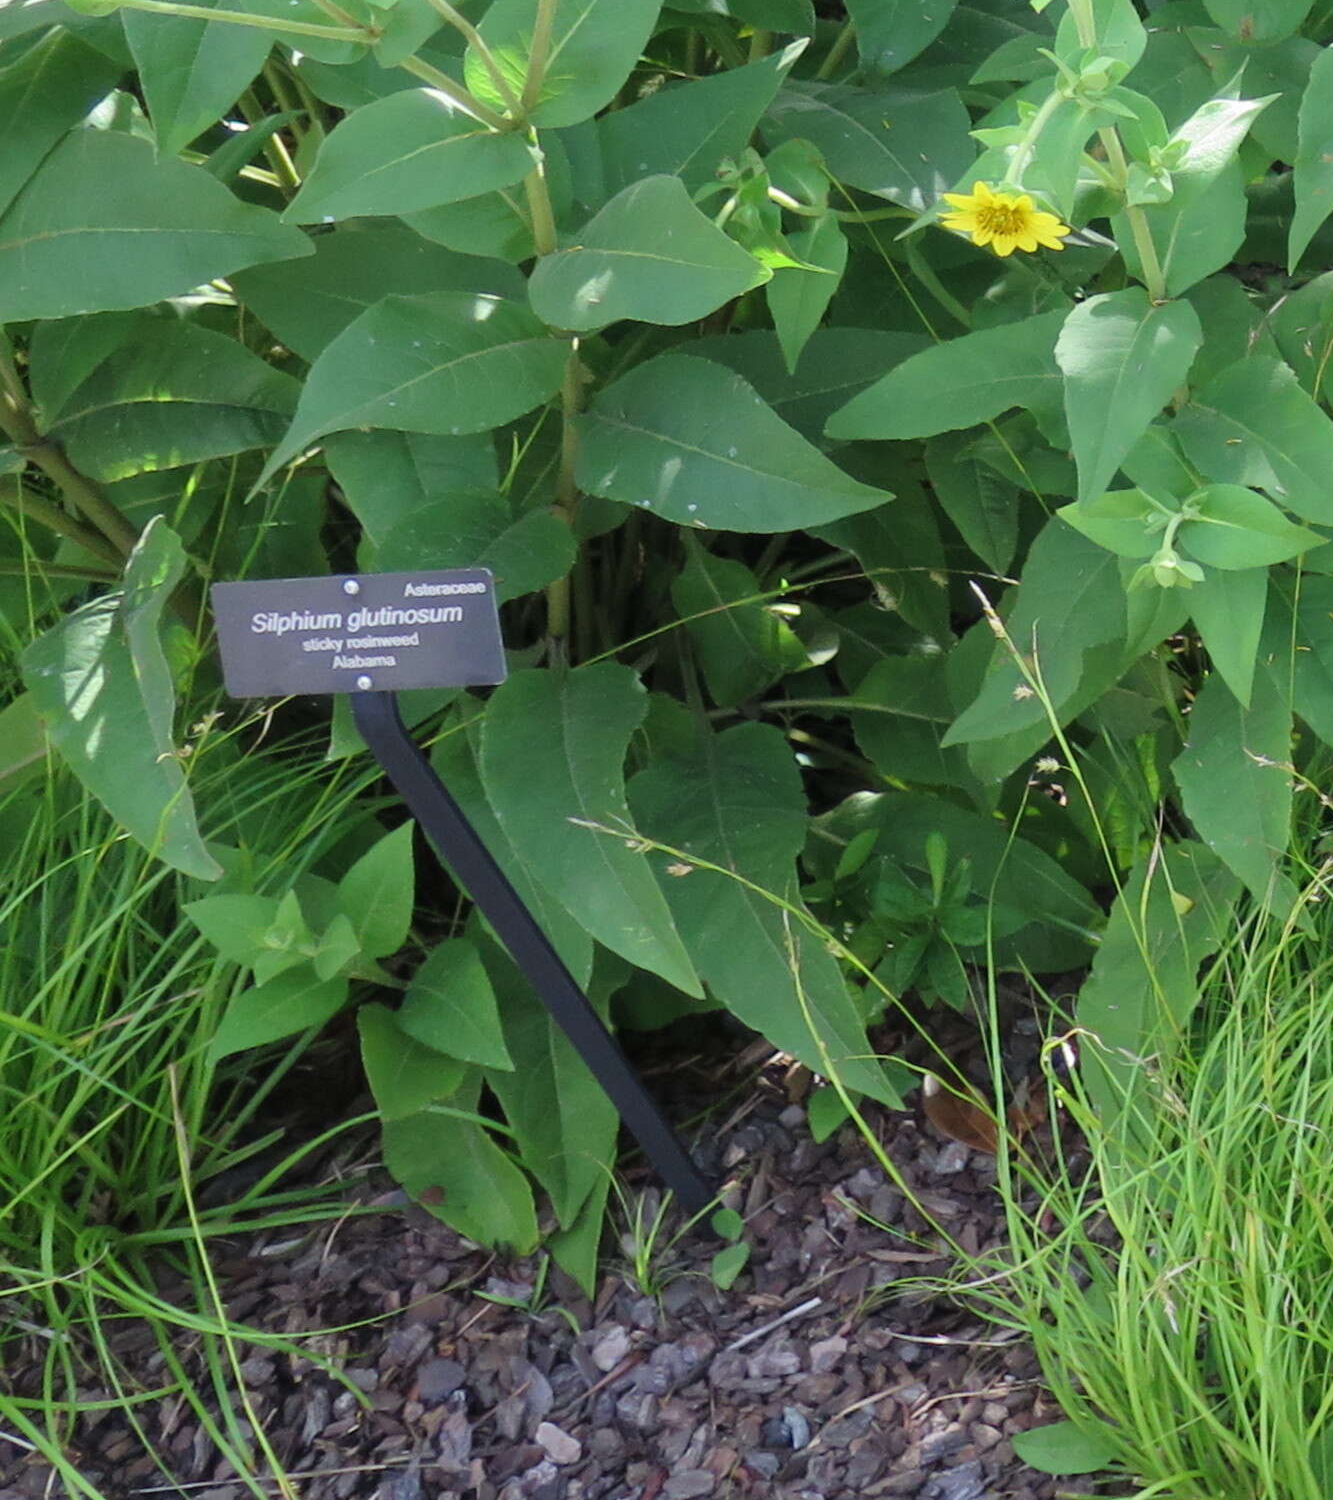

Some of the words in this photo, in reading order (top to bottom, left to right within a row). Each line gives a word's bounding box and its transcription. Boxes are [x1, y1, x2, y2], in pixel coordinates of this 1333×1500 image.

[404, 580, 486, 597] Asteraceae
[251, 609, 342, 636] Silphium
[347, 606, 463, 632] glutinosum
[303, 635, 343, 653] sticky
[346, 632, 420, 650] rosinweed
[332, 654, 396, 669] Alabama
